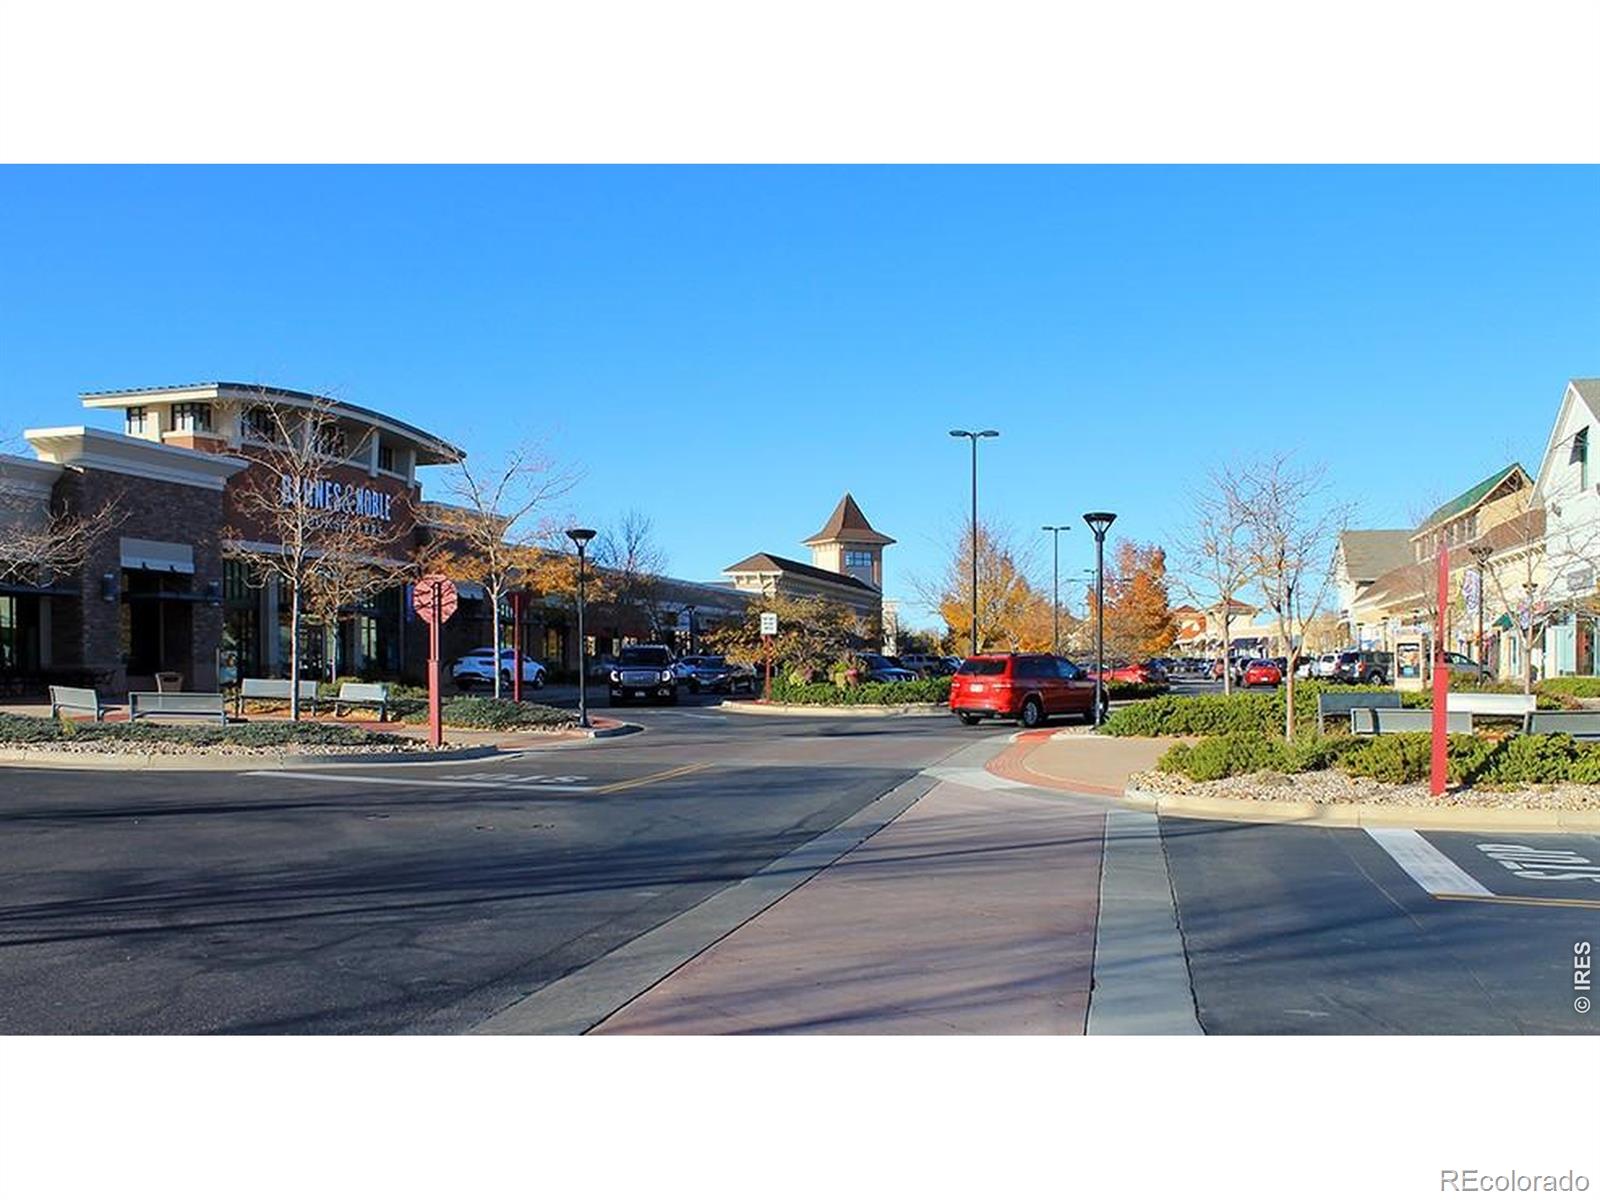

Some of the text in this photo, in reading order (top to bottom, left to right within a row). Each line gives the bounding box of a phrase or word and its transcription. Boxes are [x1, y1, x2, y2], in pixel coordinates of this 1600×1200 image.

[281, 474, 341, 512] BRNES
[355, 487, 391, 520] NOBLE
[1475, 843, 1600, 883] STOP
